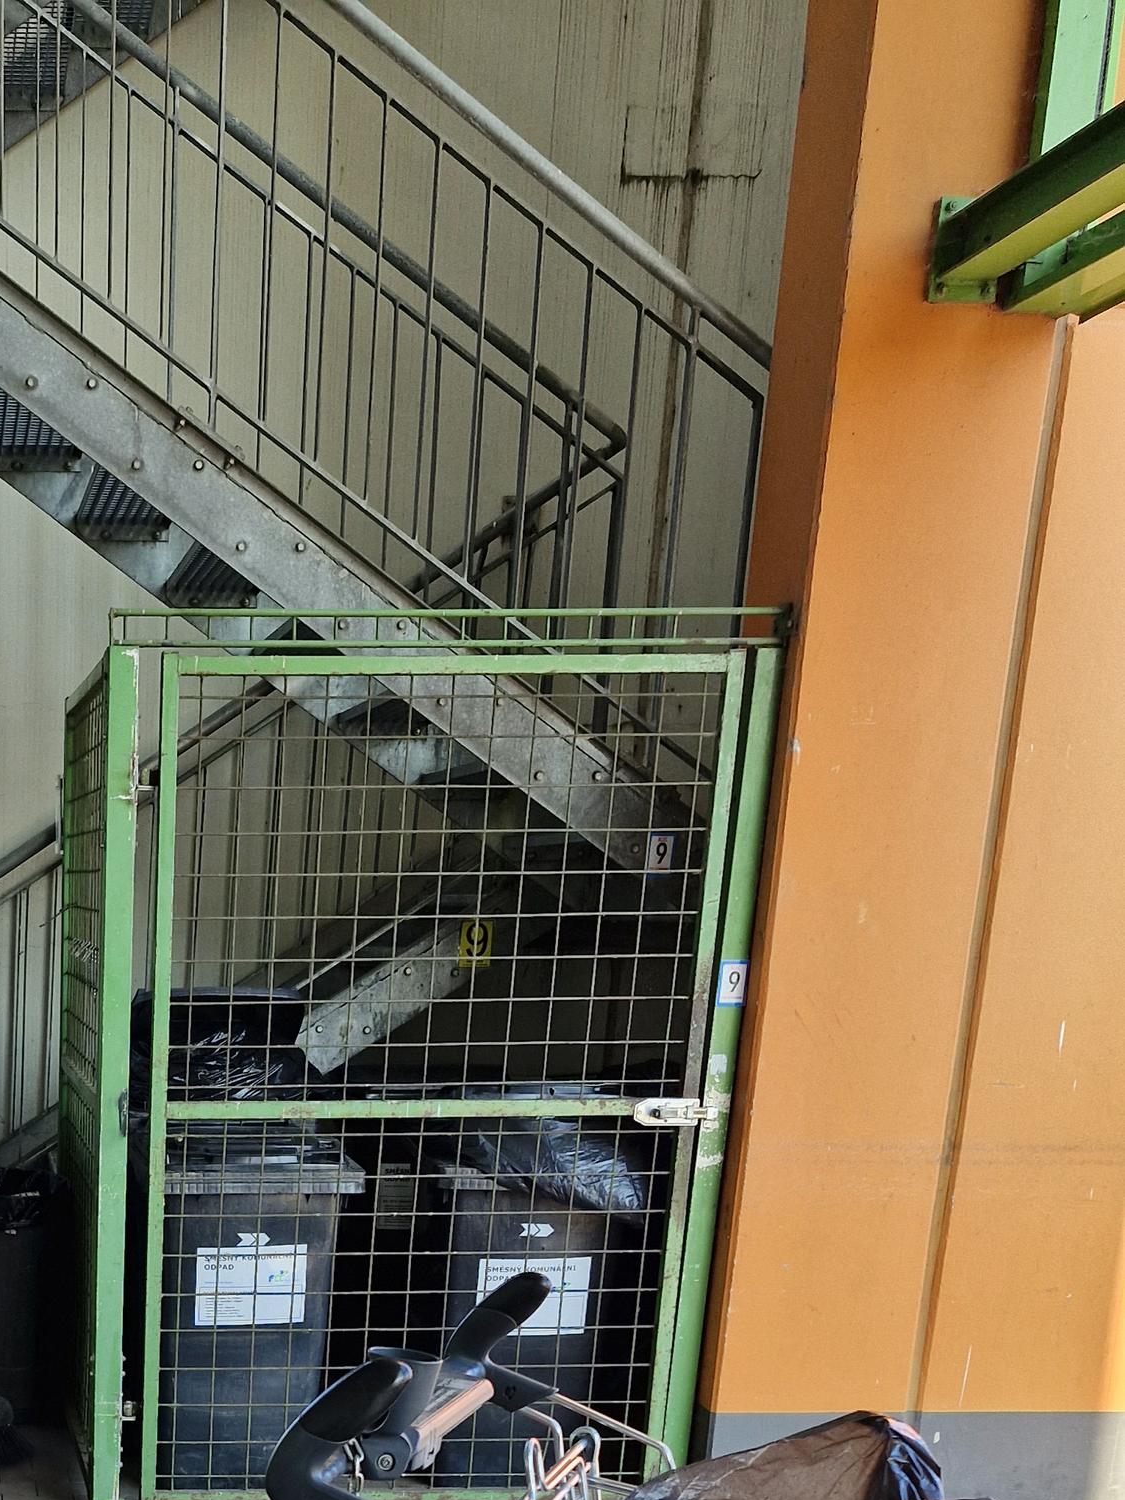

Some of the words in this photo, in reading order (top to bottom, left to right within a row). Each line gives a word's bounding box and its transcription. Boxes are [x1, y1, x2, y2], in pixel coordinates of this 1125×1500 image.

[656, 842, 668, 865] 9
[466, 922, 489, 958] 9
[728, 970, 741, 993] 9
[203, 1263, 235, 1271] ODPAD
[525, 1263, 577, 1273] OMUNÁNÍ
